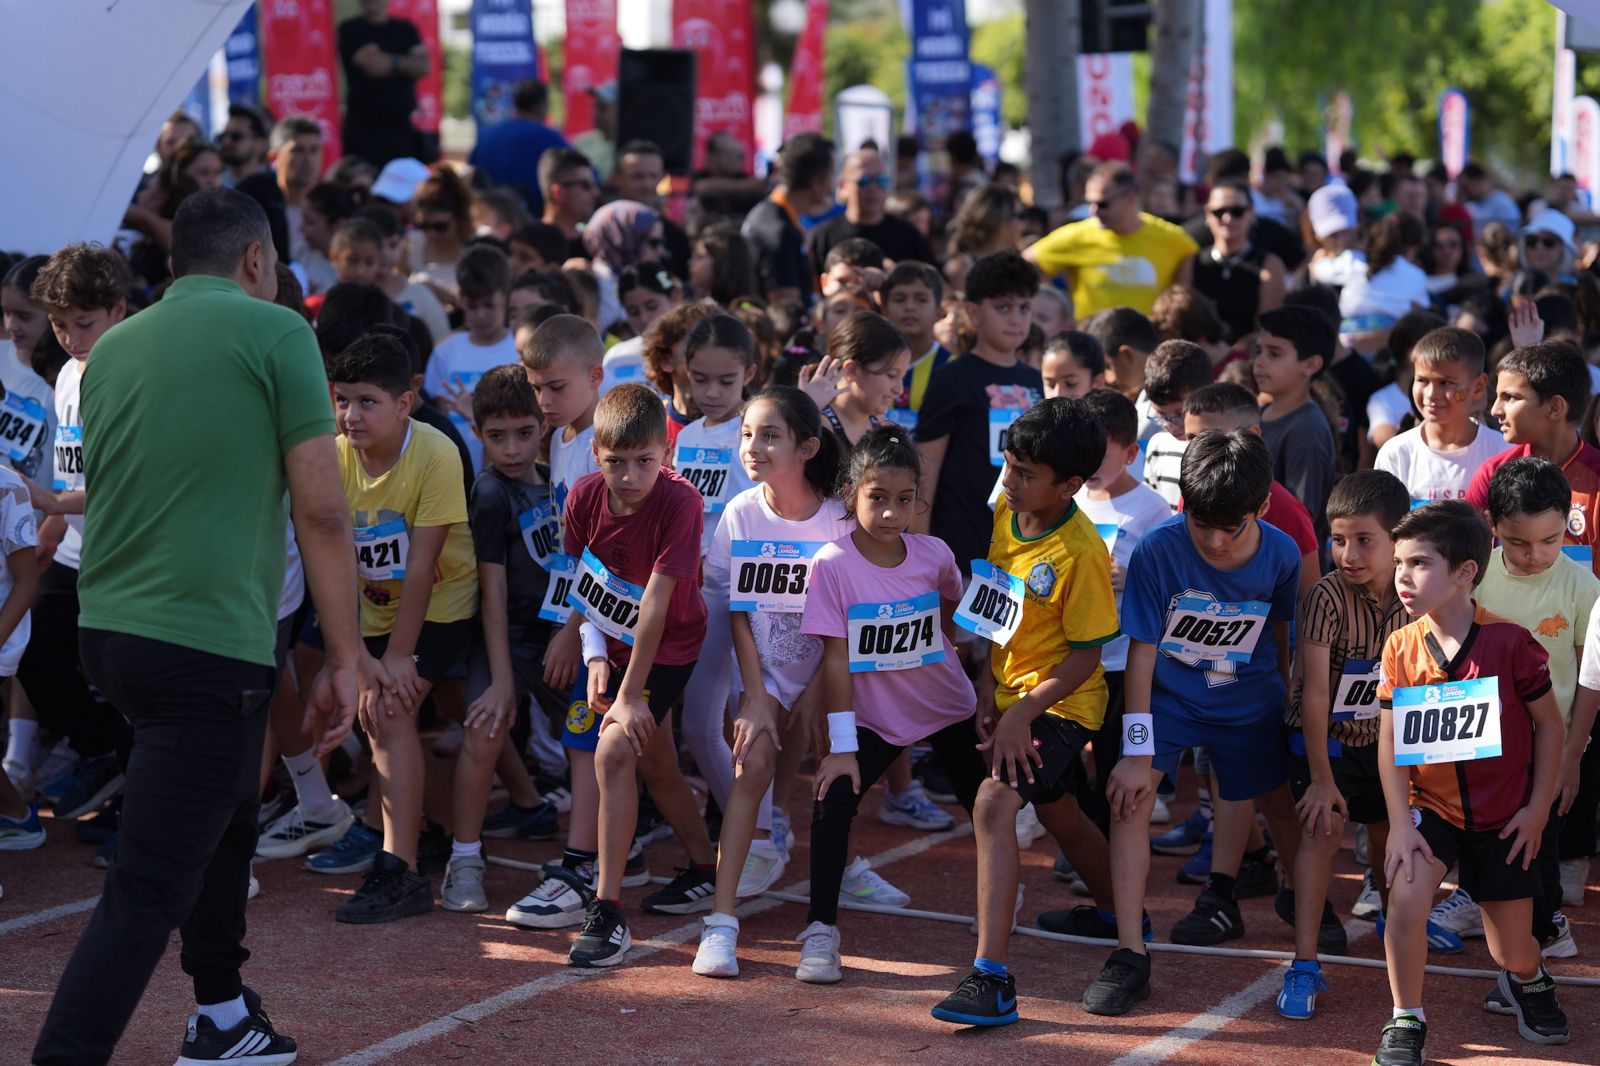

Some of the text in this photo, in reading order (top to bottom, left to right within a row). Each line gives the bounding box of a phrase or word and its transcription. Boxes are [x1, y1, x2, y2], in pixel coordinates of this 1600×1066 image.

[0, 409, 35, 446] 034
[354, 538, 400, 568] 421
[737, 562, 808, 595] 0063
[577, 572, 640, 629] 00607
[968, 583, 1019, 631] 00277
[858, 615, 933, 655] 00274
[1170, 615, 1257, 646] 00527
[1402, 702, 1490, 745] 00827
